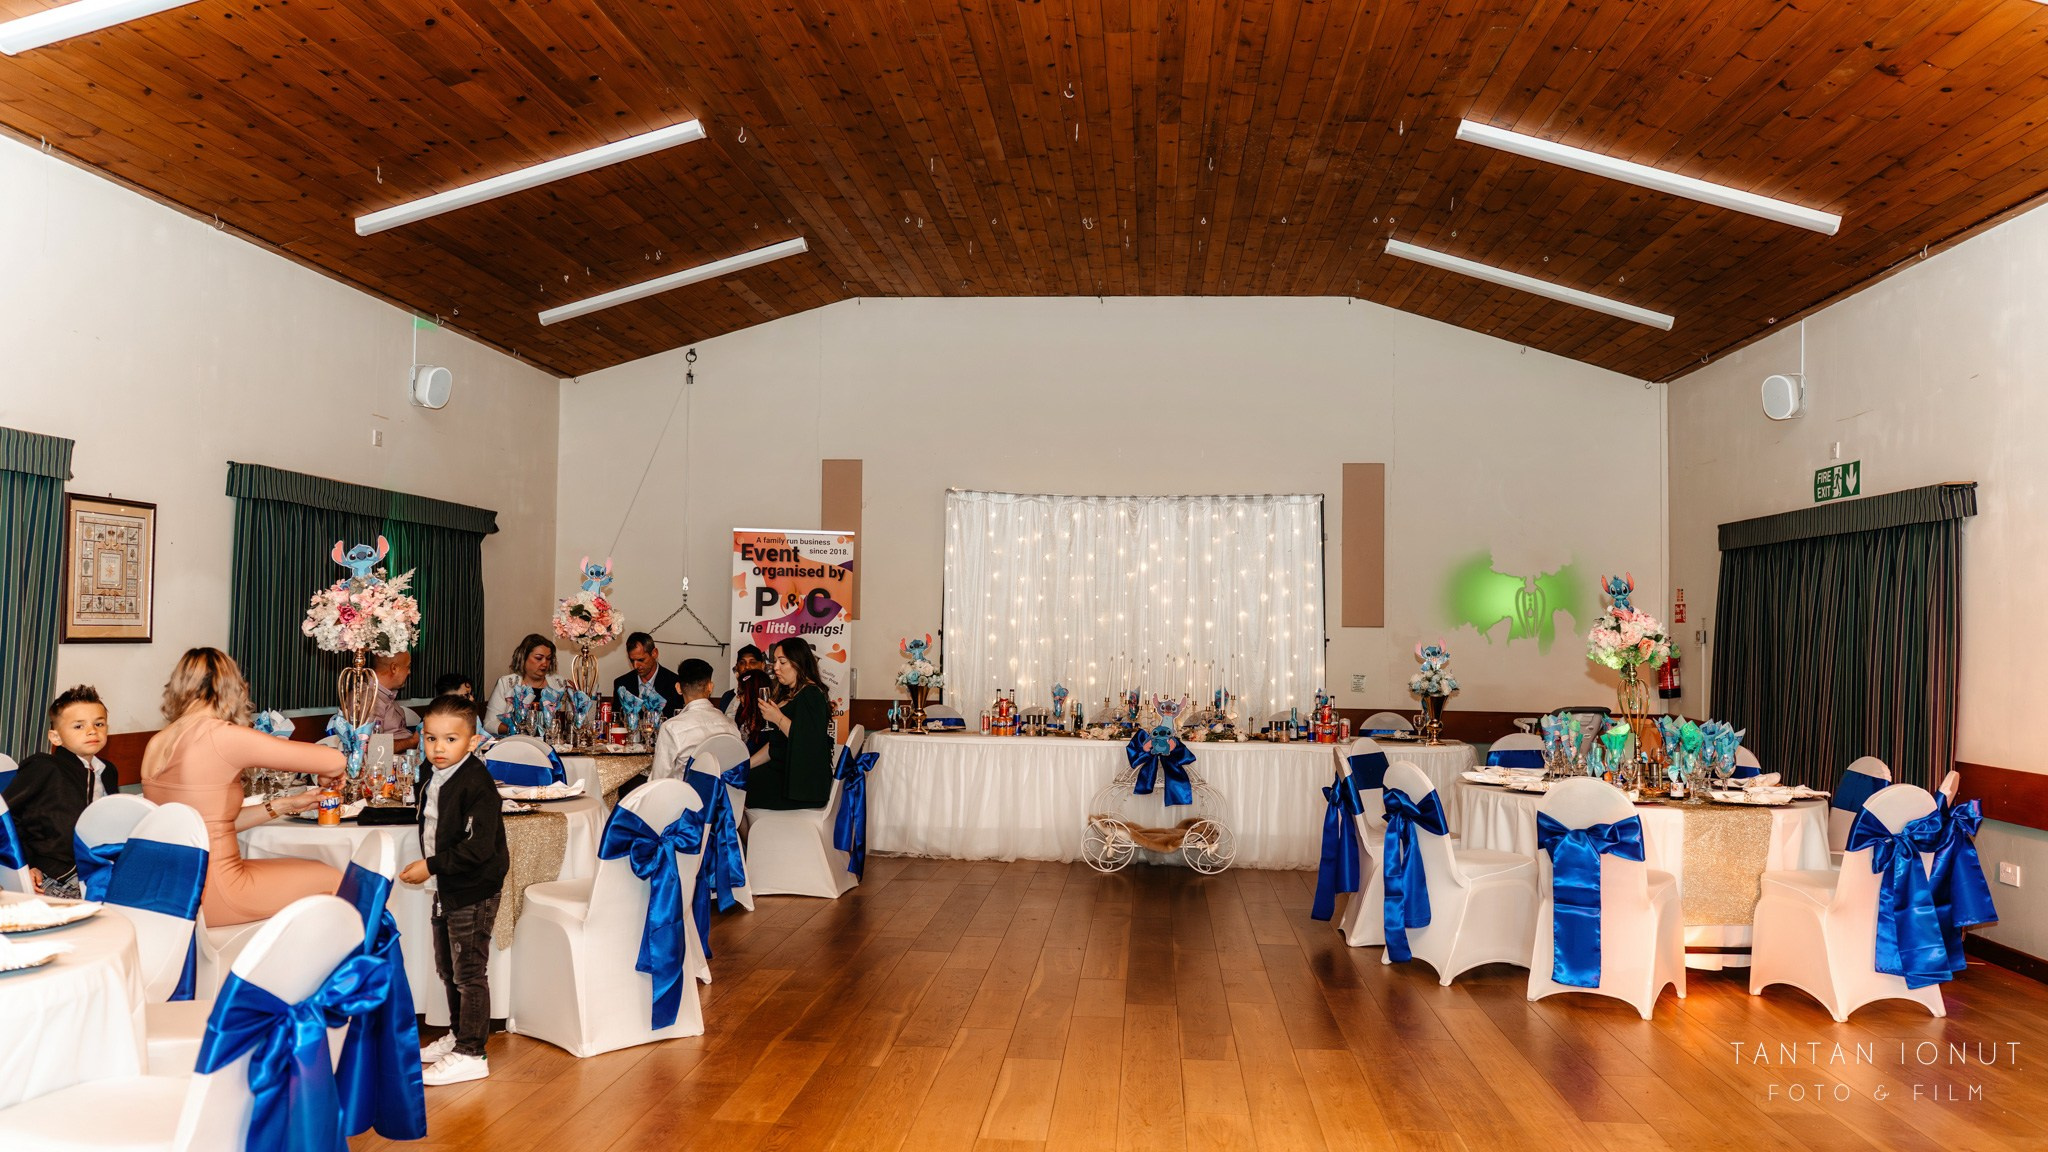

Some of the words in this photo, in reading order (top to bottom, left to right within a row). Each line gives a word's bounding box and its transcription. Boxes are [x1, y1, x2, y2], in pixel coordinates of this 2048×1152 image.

[1817, 470, 1831, 484] FIRE
[1817, 485, 1831, 499] EXIT
[763, 537, 785, 546] family
[800, 538, 831, 546] business
[741, 543, 800, 562] Event
[809, 547, 828, 555] since
[829, 548, 849, 556] 2018.
[752, 564, 824, 580] organised
[829, 565, 845, 581] by
[755, 586, 779, 616] P
[786, 593, 799, 610] &
[806, 588, 831, 618] C
[739, 621, 763, 633] The
[765, 621, 796, 634] little
[800, 622, 844, 637] things!
[376, 745, 385, 765] 2
